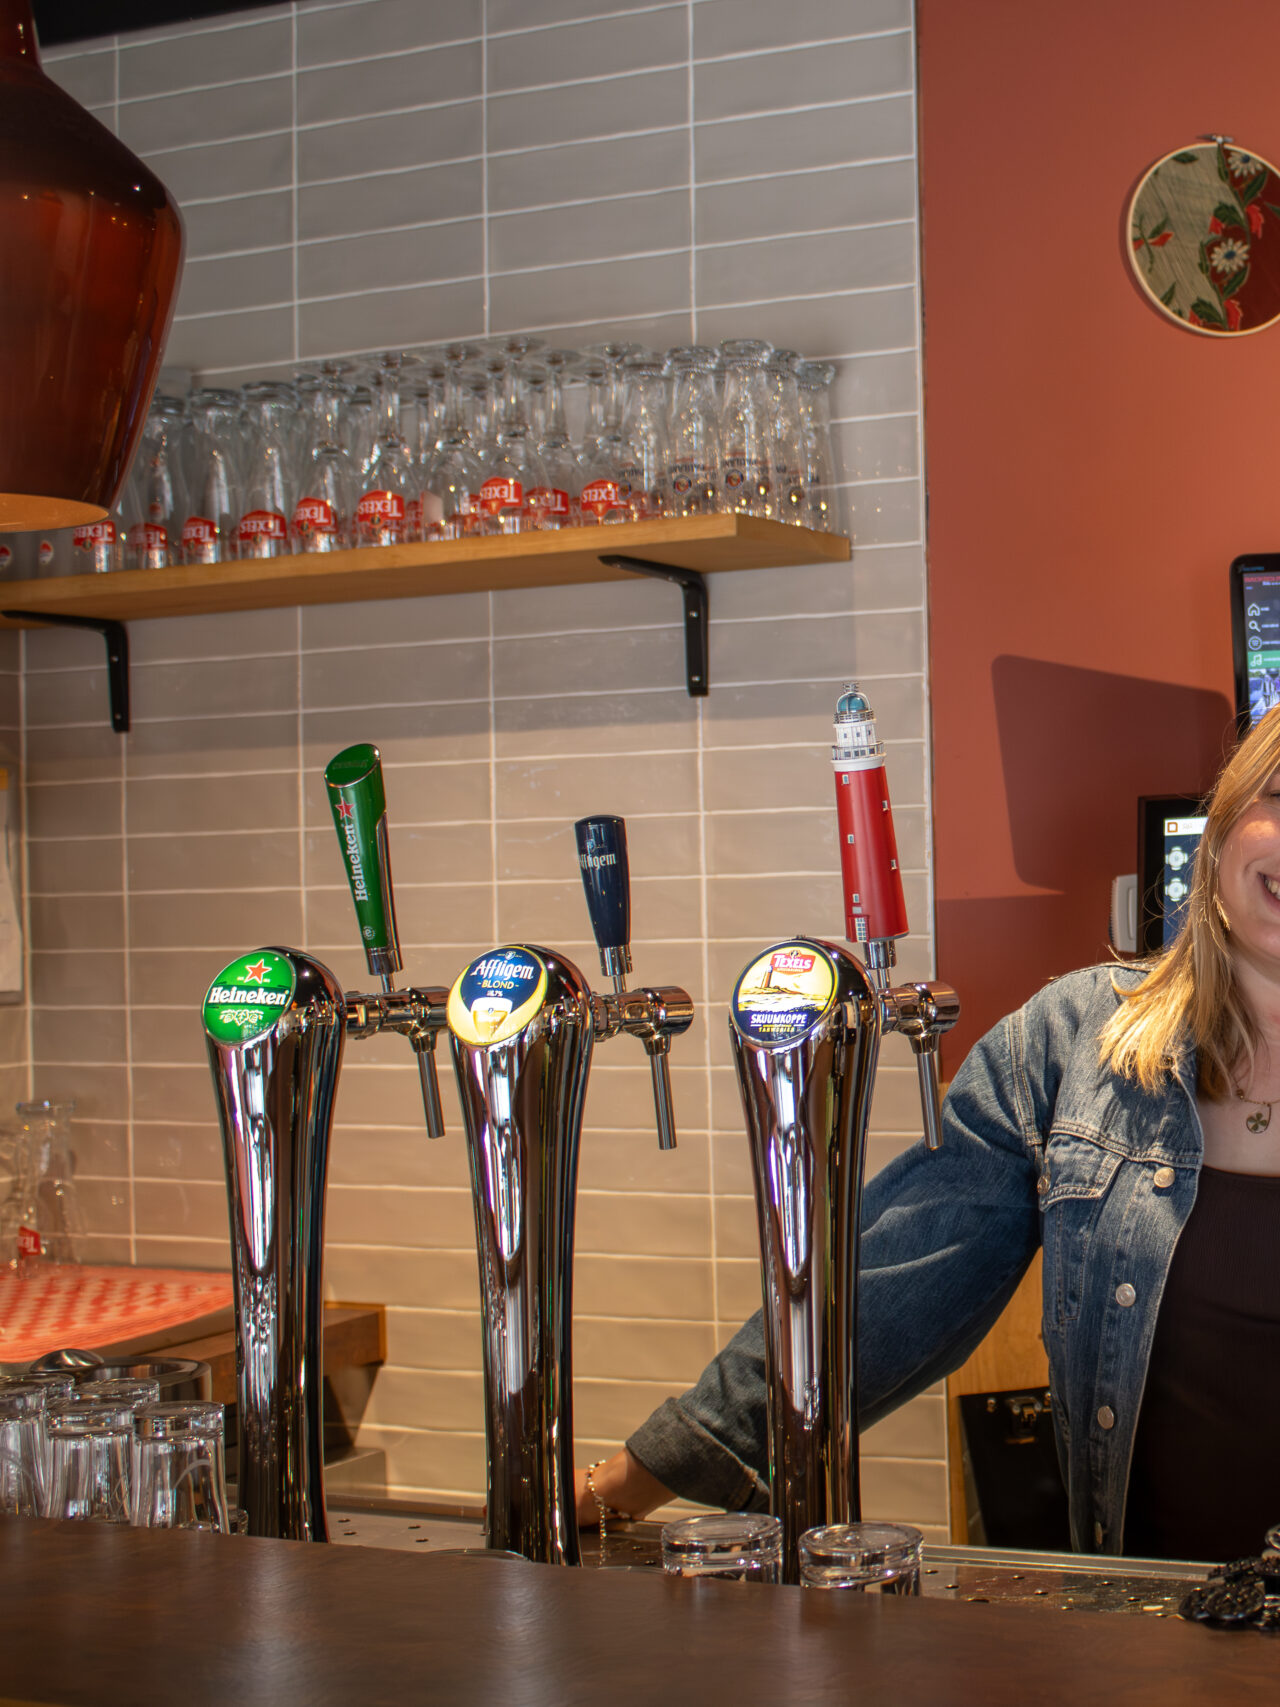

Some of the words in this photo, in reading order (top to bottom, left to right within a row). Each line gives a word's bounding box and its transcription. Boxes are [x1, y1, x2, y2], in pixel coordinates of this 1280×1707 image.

[357, 499, 402, 517] TEXELS
[240, 519, 285, 537] TEXELS
[344, 823, 370, 901] Heineken
[580, 853, 617, 870] ffligem
[469, 959, 535, 981] Affligem
[774, 954, 813, 970] TEXELS
[482, 979, 515, 990] BLOND
[208, 986, 288, 1006] Heineken
[750, 1013, 808, 1025] SKUUMKOPPE
